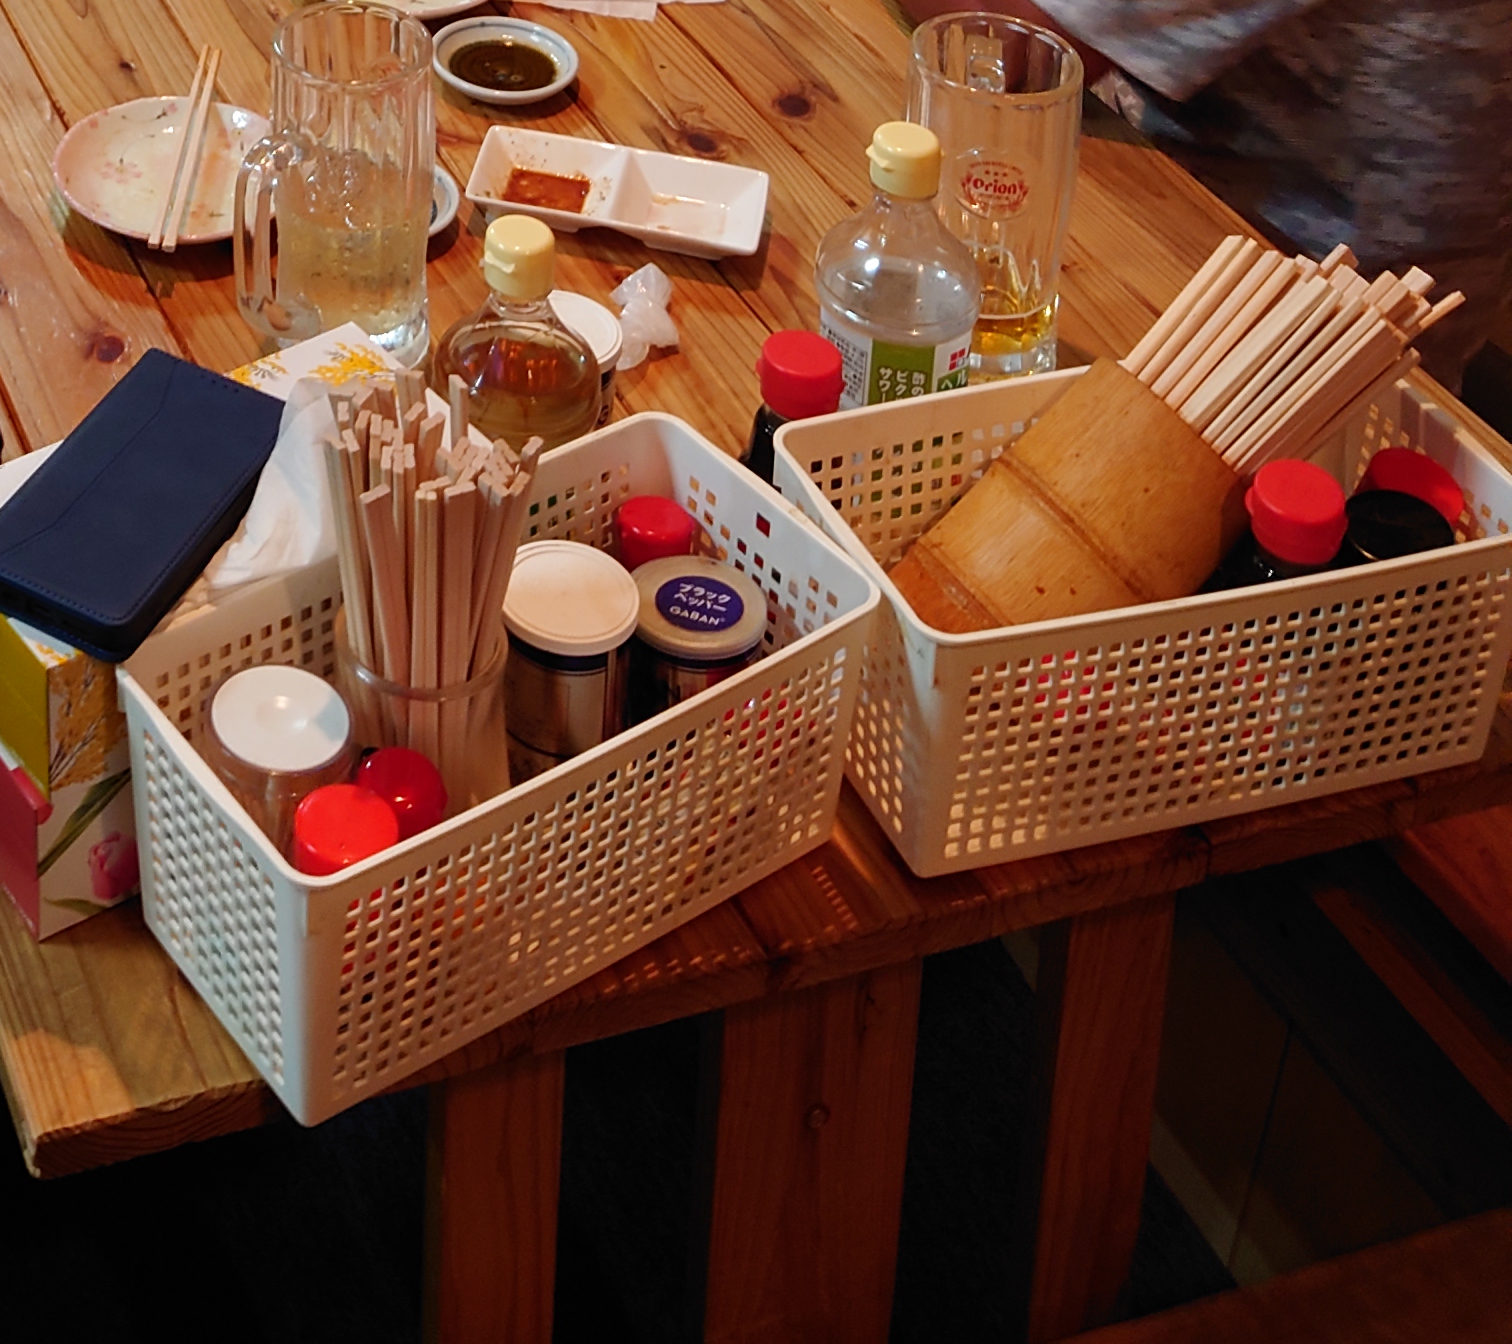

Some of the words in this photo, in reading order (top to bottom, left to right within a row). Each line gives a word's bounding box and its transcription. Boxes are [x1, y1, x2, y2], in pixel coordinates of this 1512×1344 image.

[673, 592, 728, 613] ペッパー
[679, 582, 732, 604] ブラック
